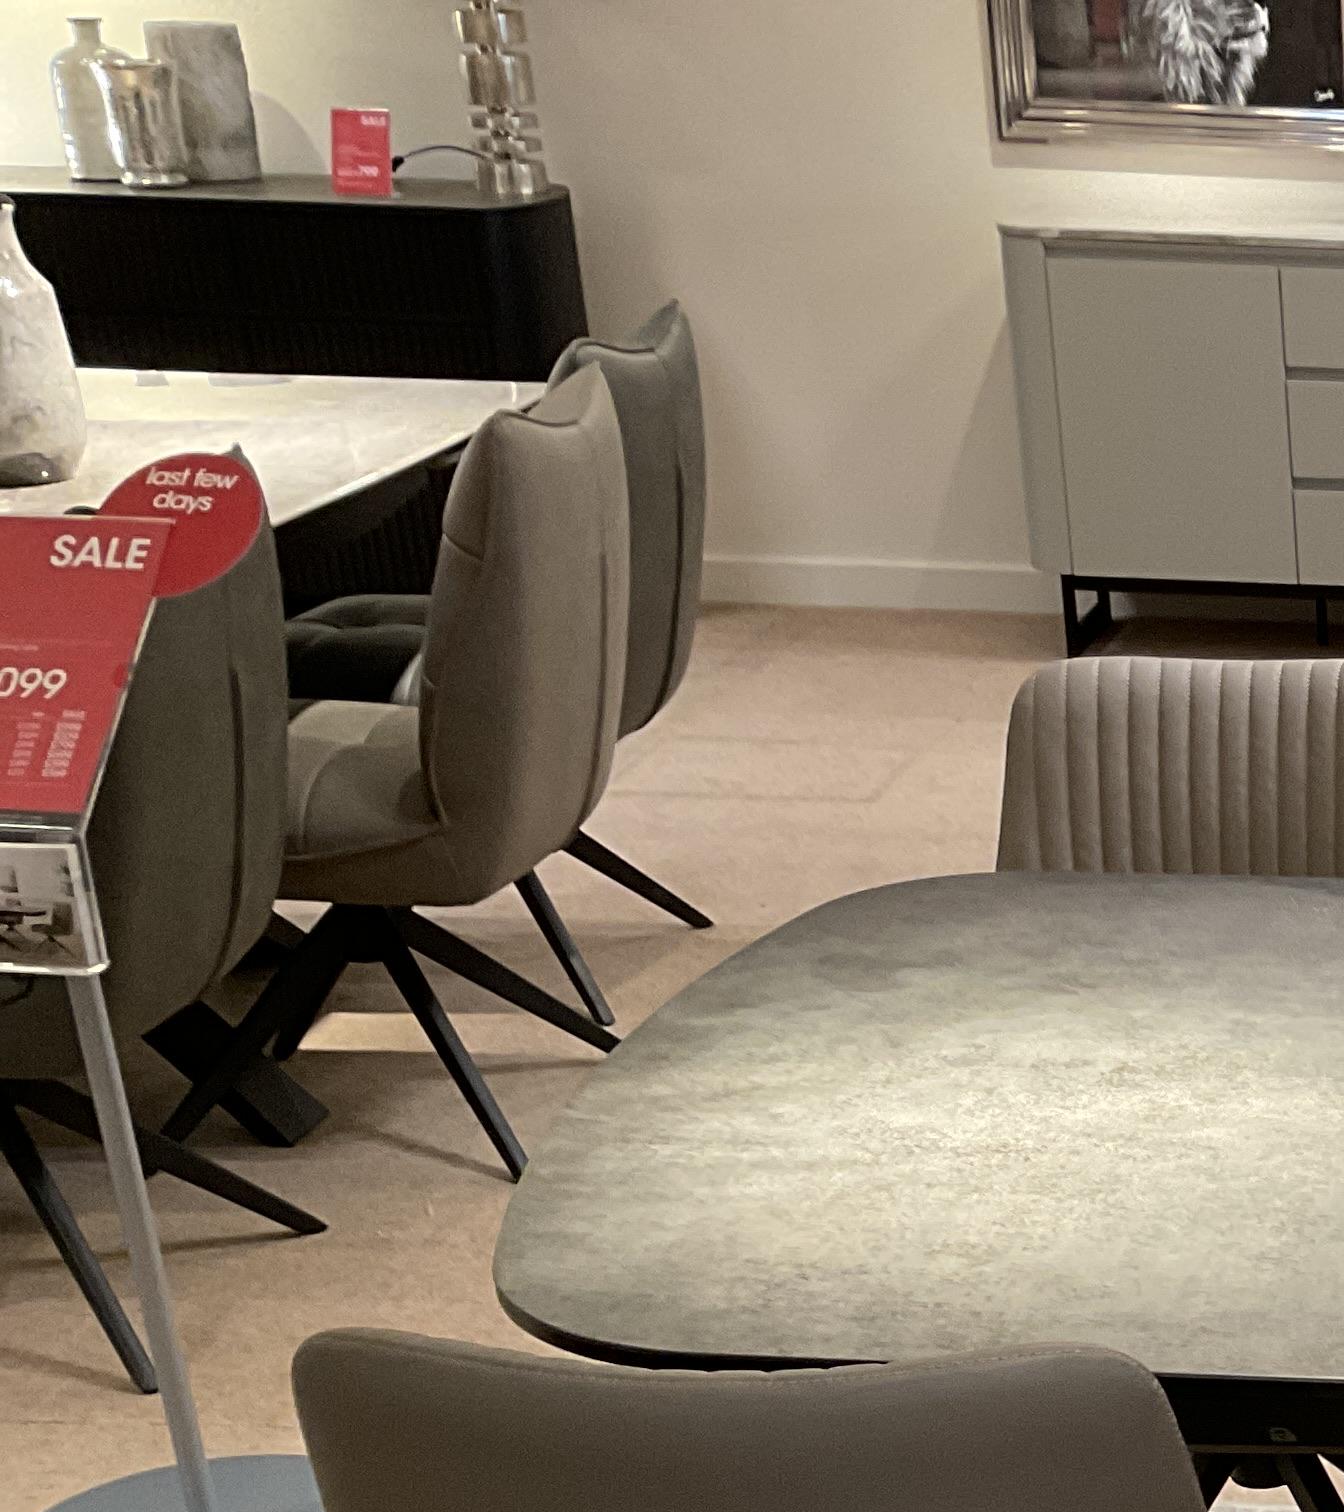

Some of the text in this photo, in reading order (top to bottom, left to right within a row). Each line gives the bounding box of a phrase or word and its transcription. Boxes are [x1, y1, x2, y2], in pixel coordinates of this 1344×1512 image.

[145, 466, 239, 490] last few
[152, 489, 214, 514] days
[49, 534, 151, 570] SALE
